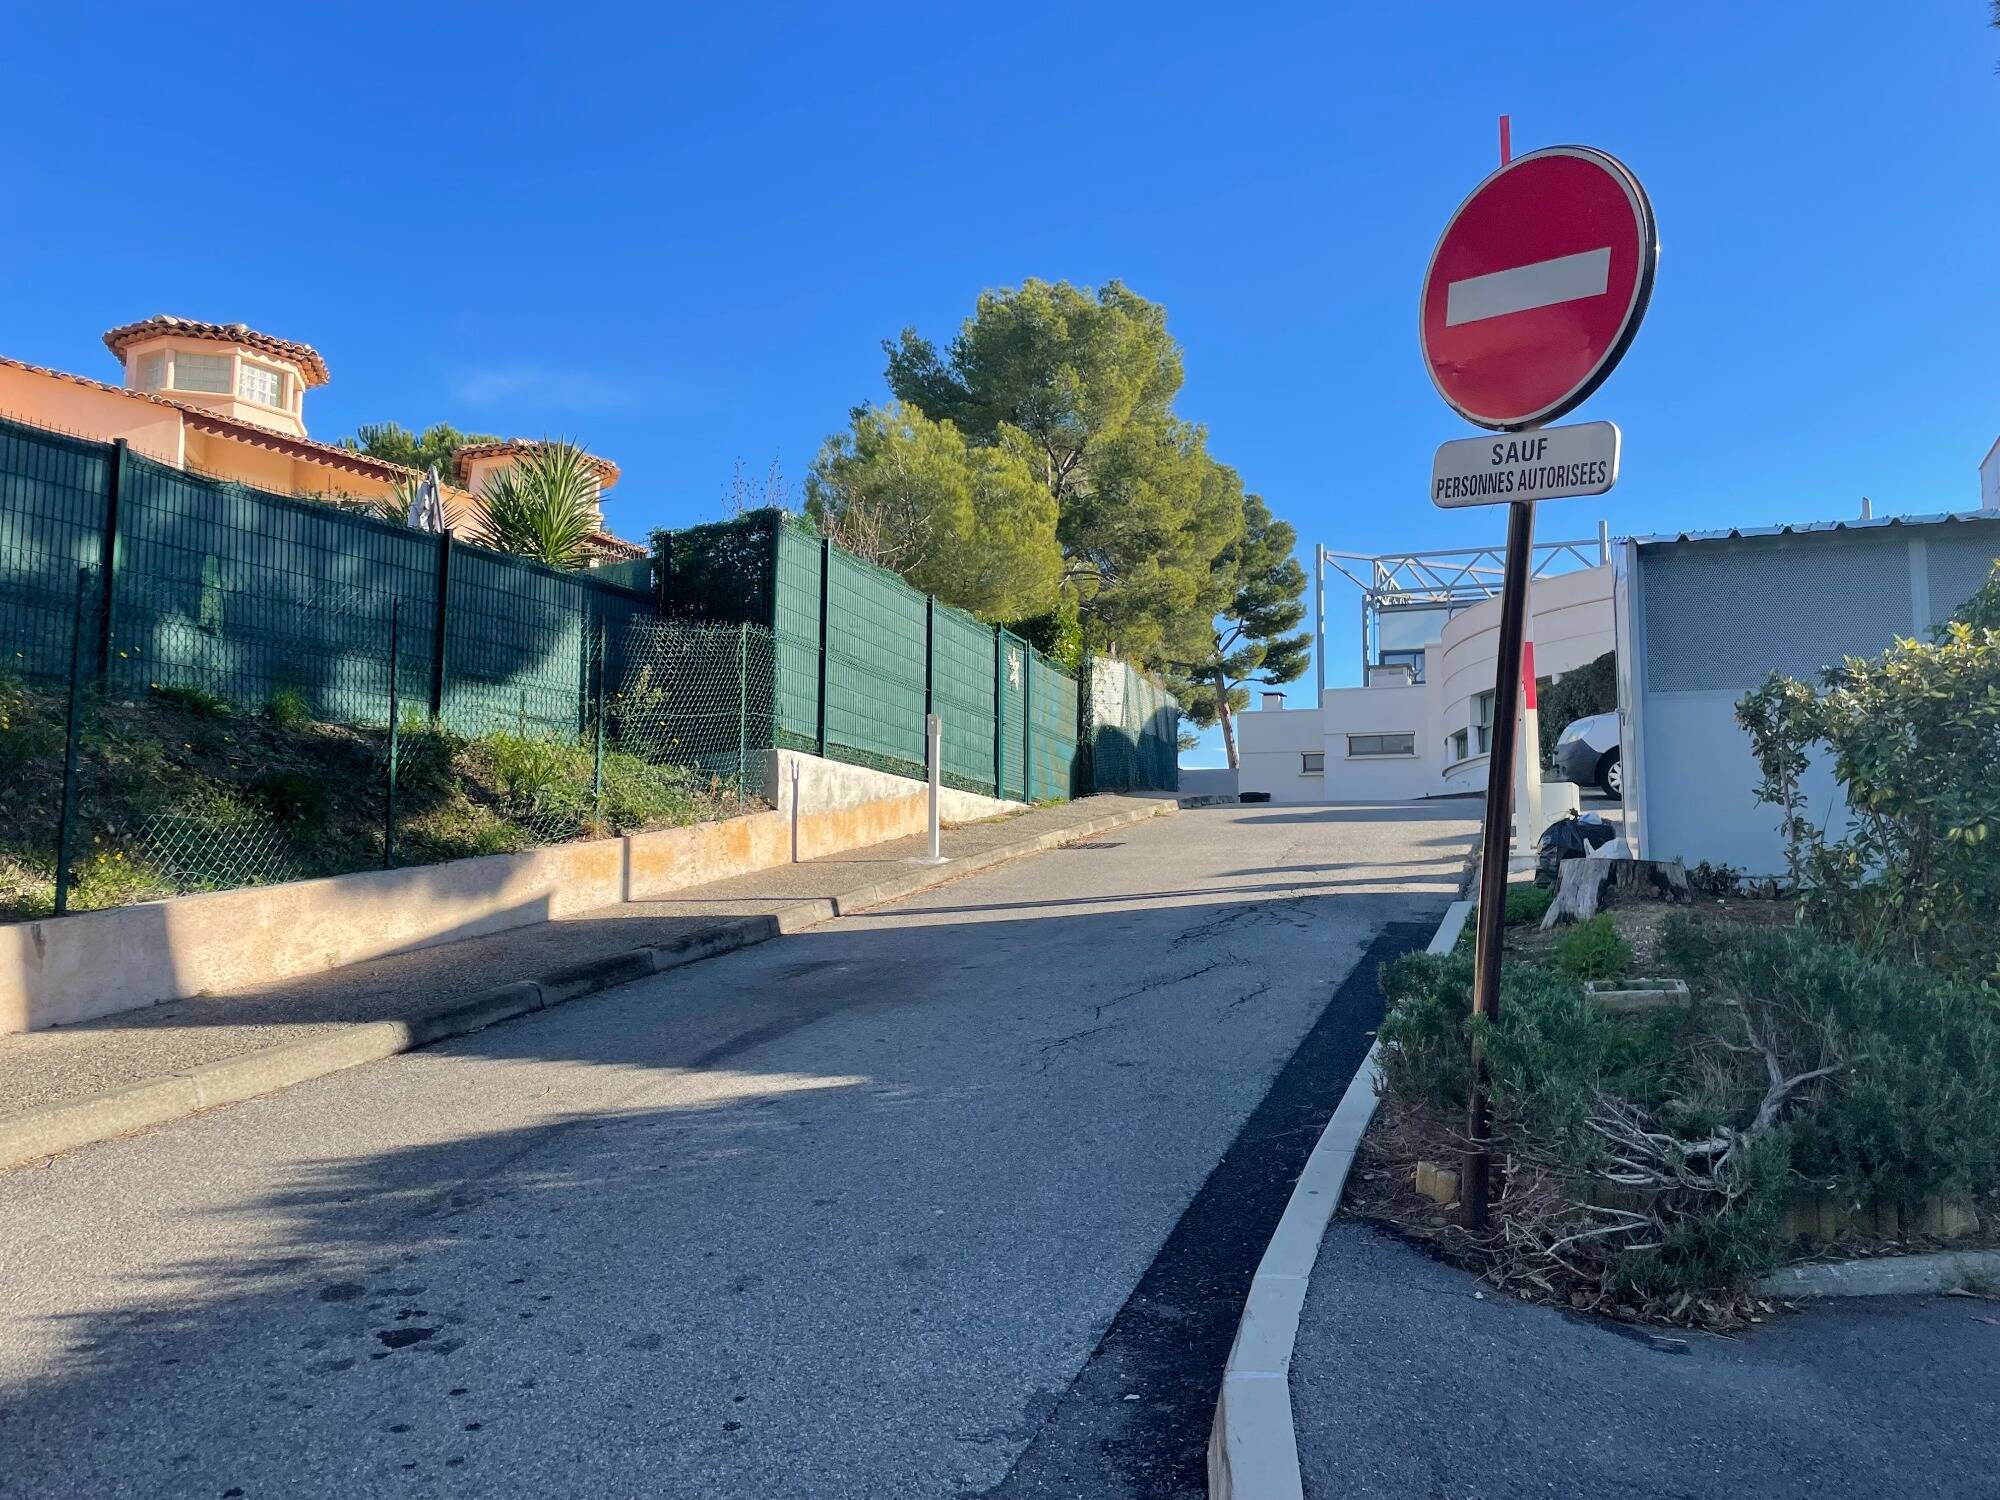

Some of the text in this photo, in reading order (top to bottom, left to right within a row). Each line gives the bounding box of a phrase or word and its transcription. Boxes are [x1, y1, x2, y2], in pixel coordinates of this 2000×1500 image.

[1491, 438, 1548, 466] SAUF
[1436, 460, 1607, 499] PERSONNES AUTORISEES
